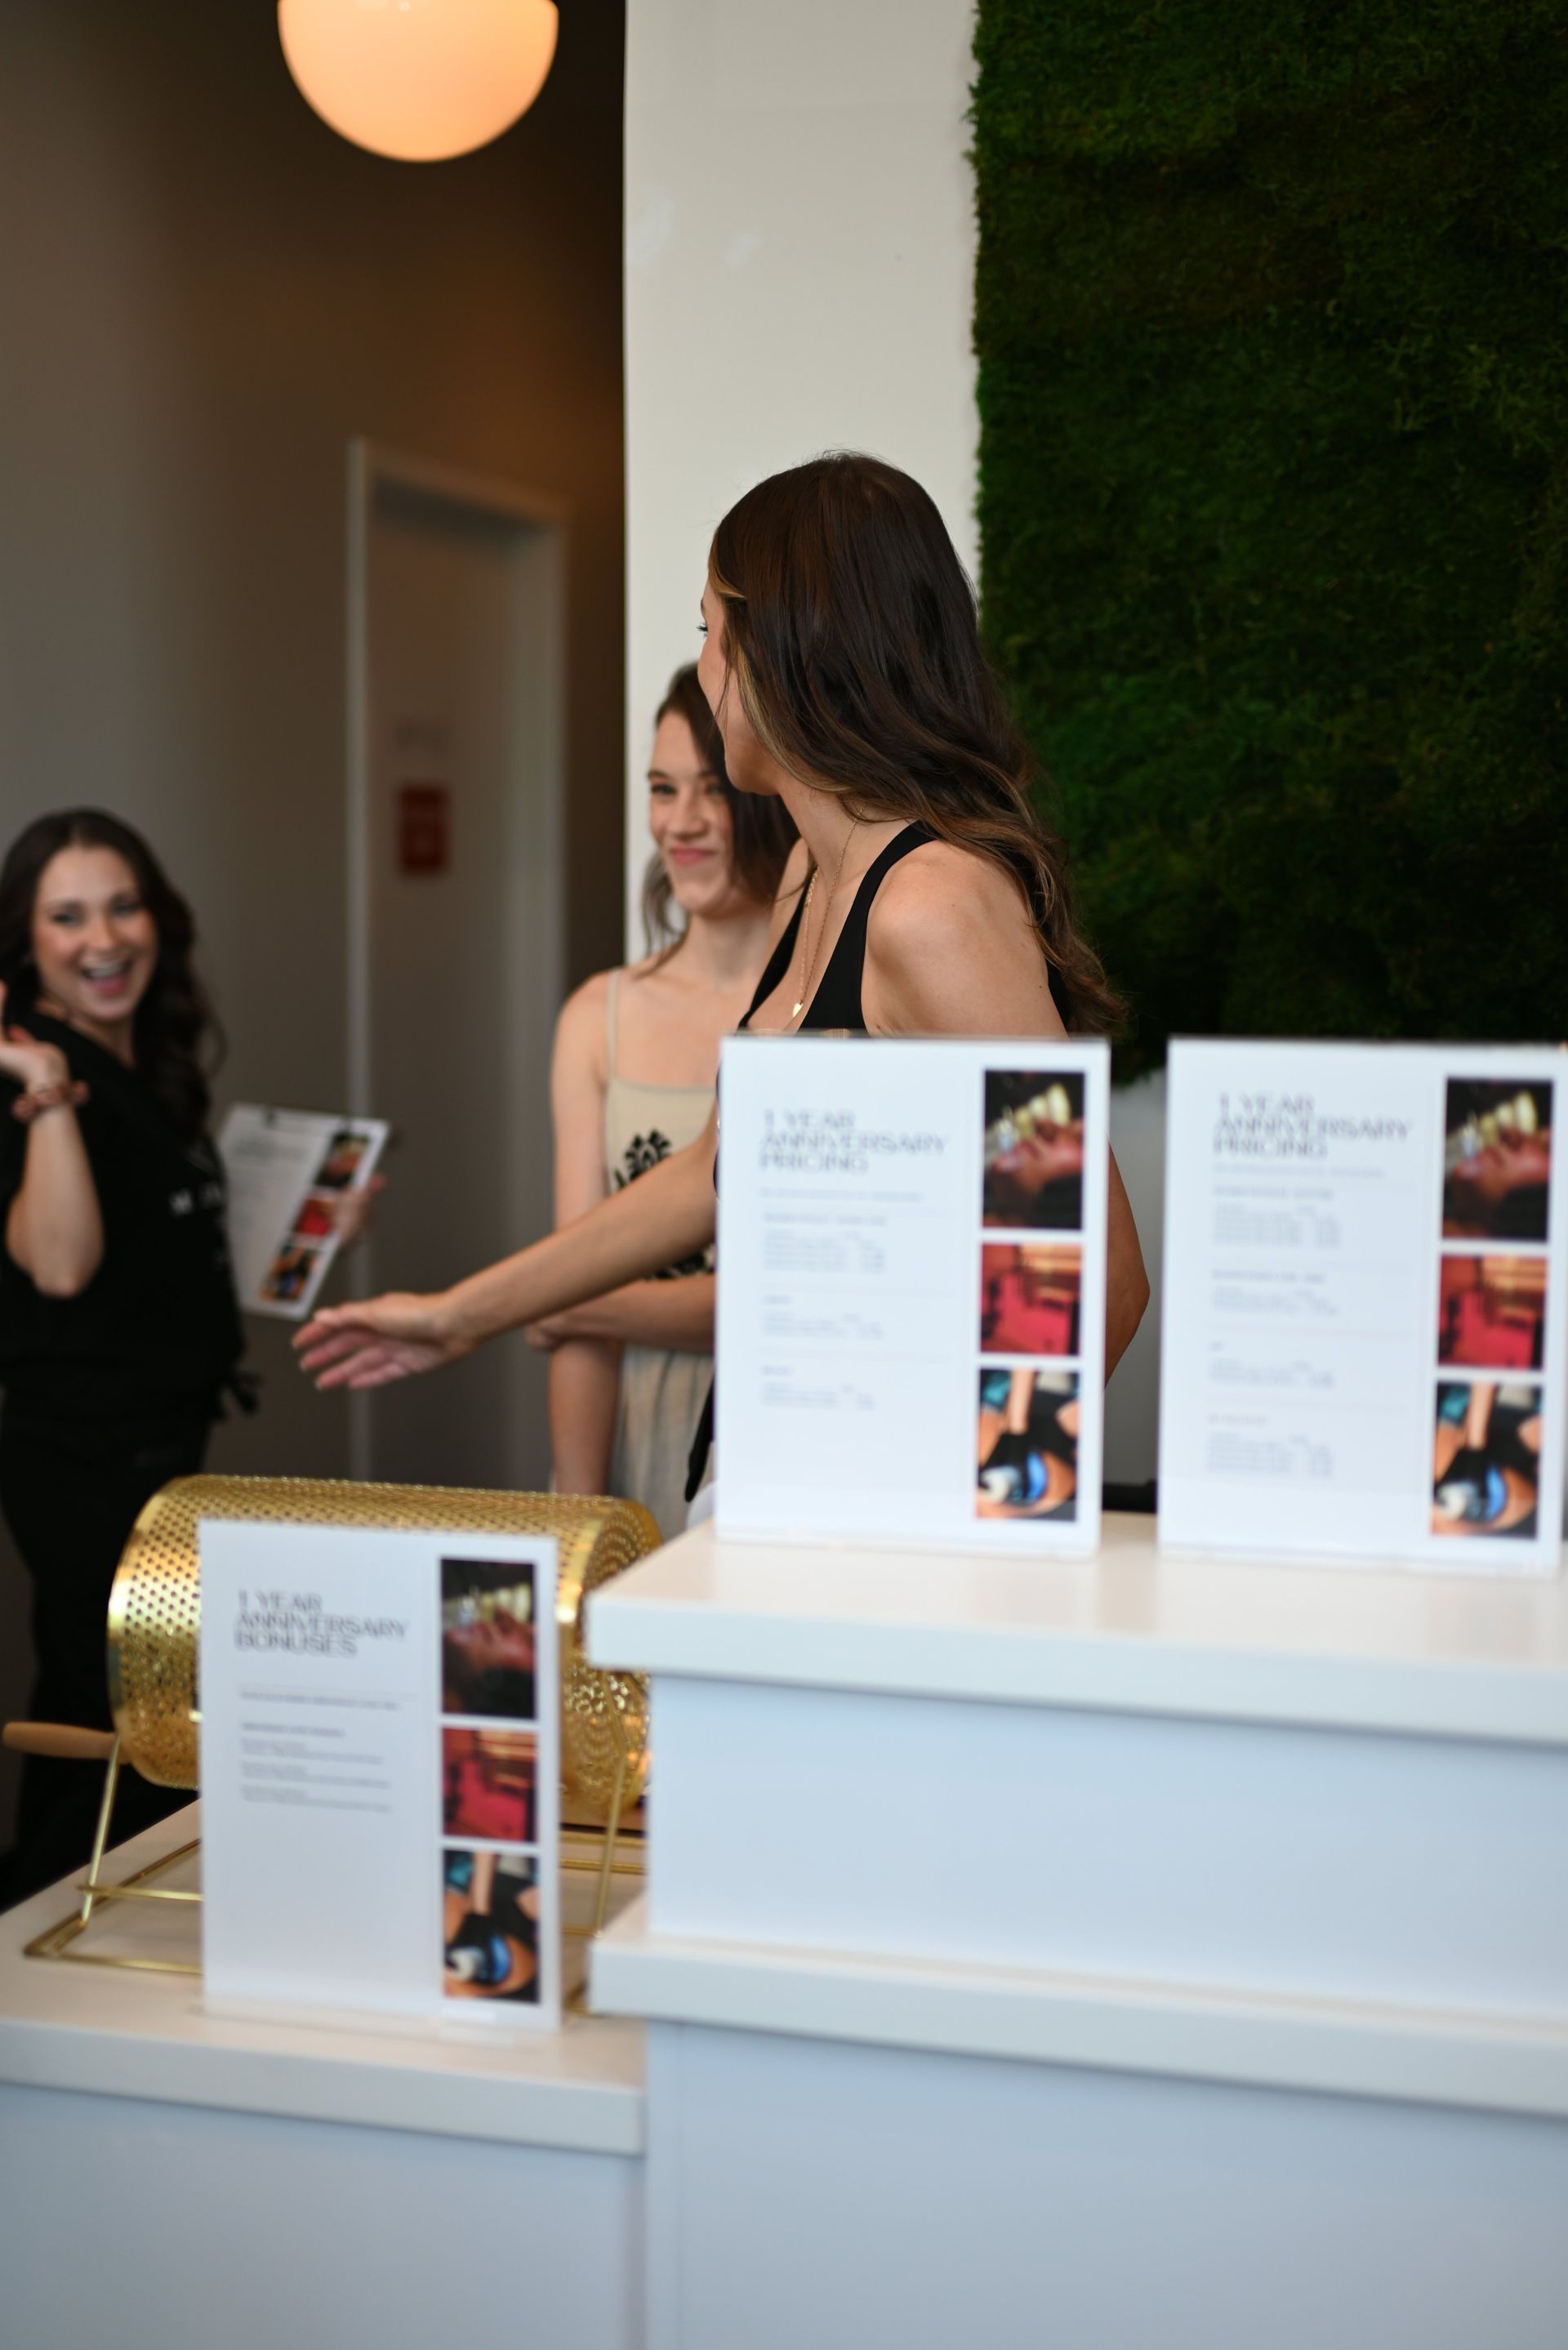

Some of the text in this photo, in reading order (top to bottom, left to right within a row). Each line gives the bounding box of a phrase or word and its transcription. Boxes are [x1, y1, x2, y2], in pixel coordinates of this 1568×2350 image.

[1239, 1090, 1315, 1116] YEAR
[782, 1108, 856, 1130] YEAR
[1214, 1113, 1412, 1142] ANNIVERSARY
[760, 1129, 950, 1156] ANNIVERSARY
[1212, 1135, 1328, 1158] PRICING
[759, 1150, 868, 1174] PRICING
[254, 1590, 323, 1614] YEAR
[235, 1610, 408, 1641] ANNIVERSARY
[234, 1630, 358, 1659] BONUSES
